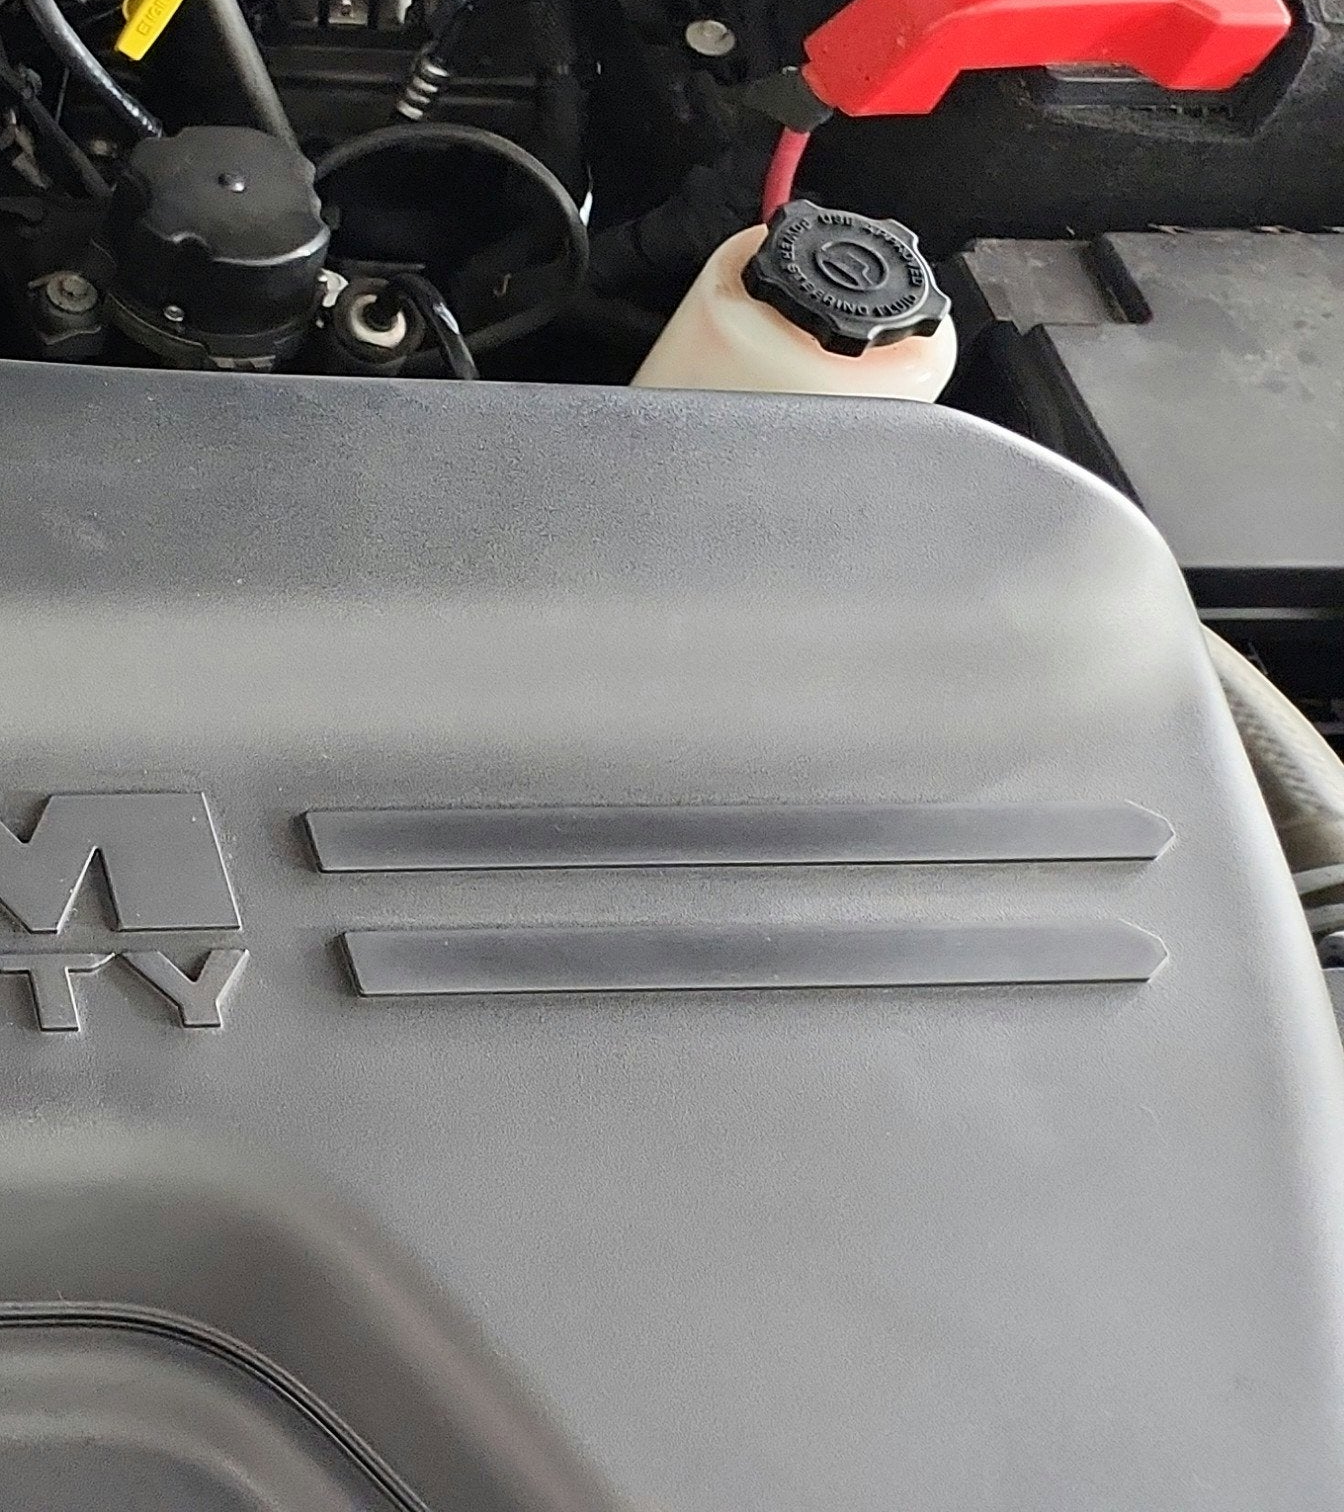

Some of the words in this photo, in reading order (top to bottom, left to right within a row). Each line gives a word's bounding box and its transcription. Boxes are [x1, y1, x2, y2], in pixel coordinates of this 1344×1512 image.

[780, 218, 812, 261] POWER
[817, 214, 853, 227] USE
[862, 224, 924, 287] APPROVED
[787, 262, 870, 316] STEERING
[872, 293, 918, 317] FLUID
